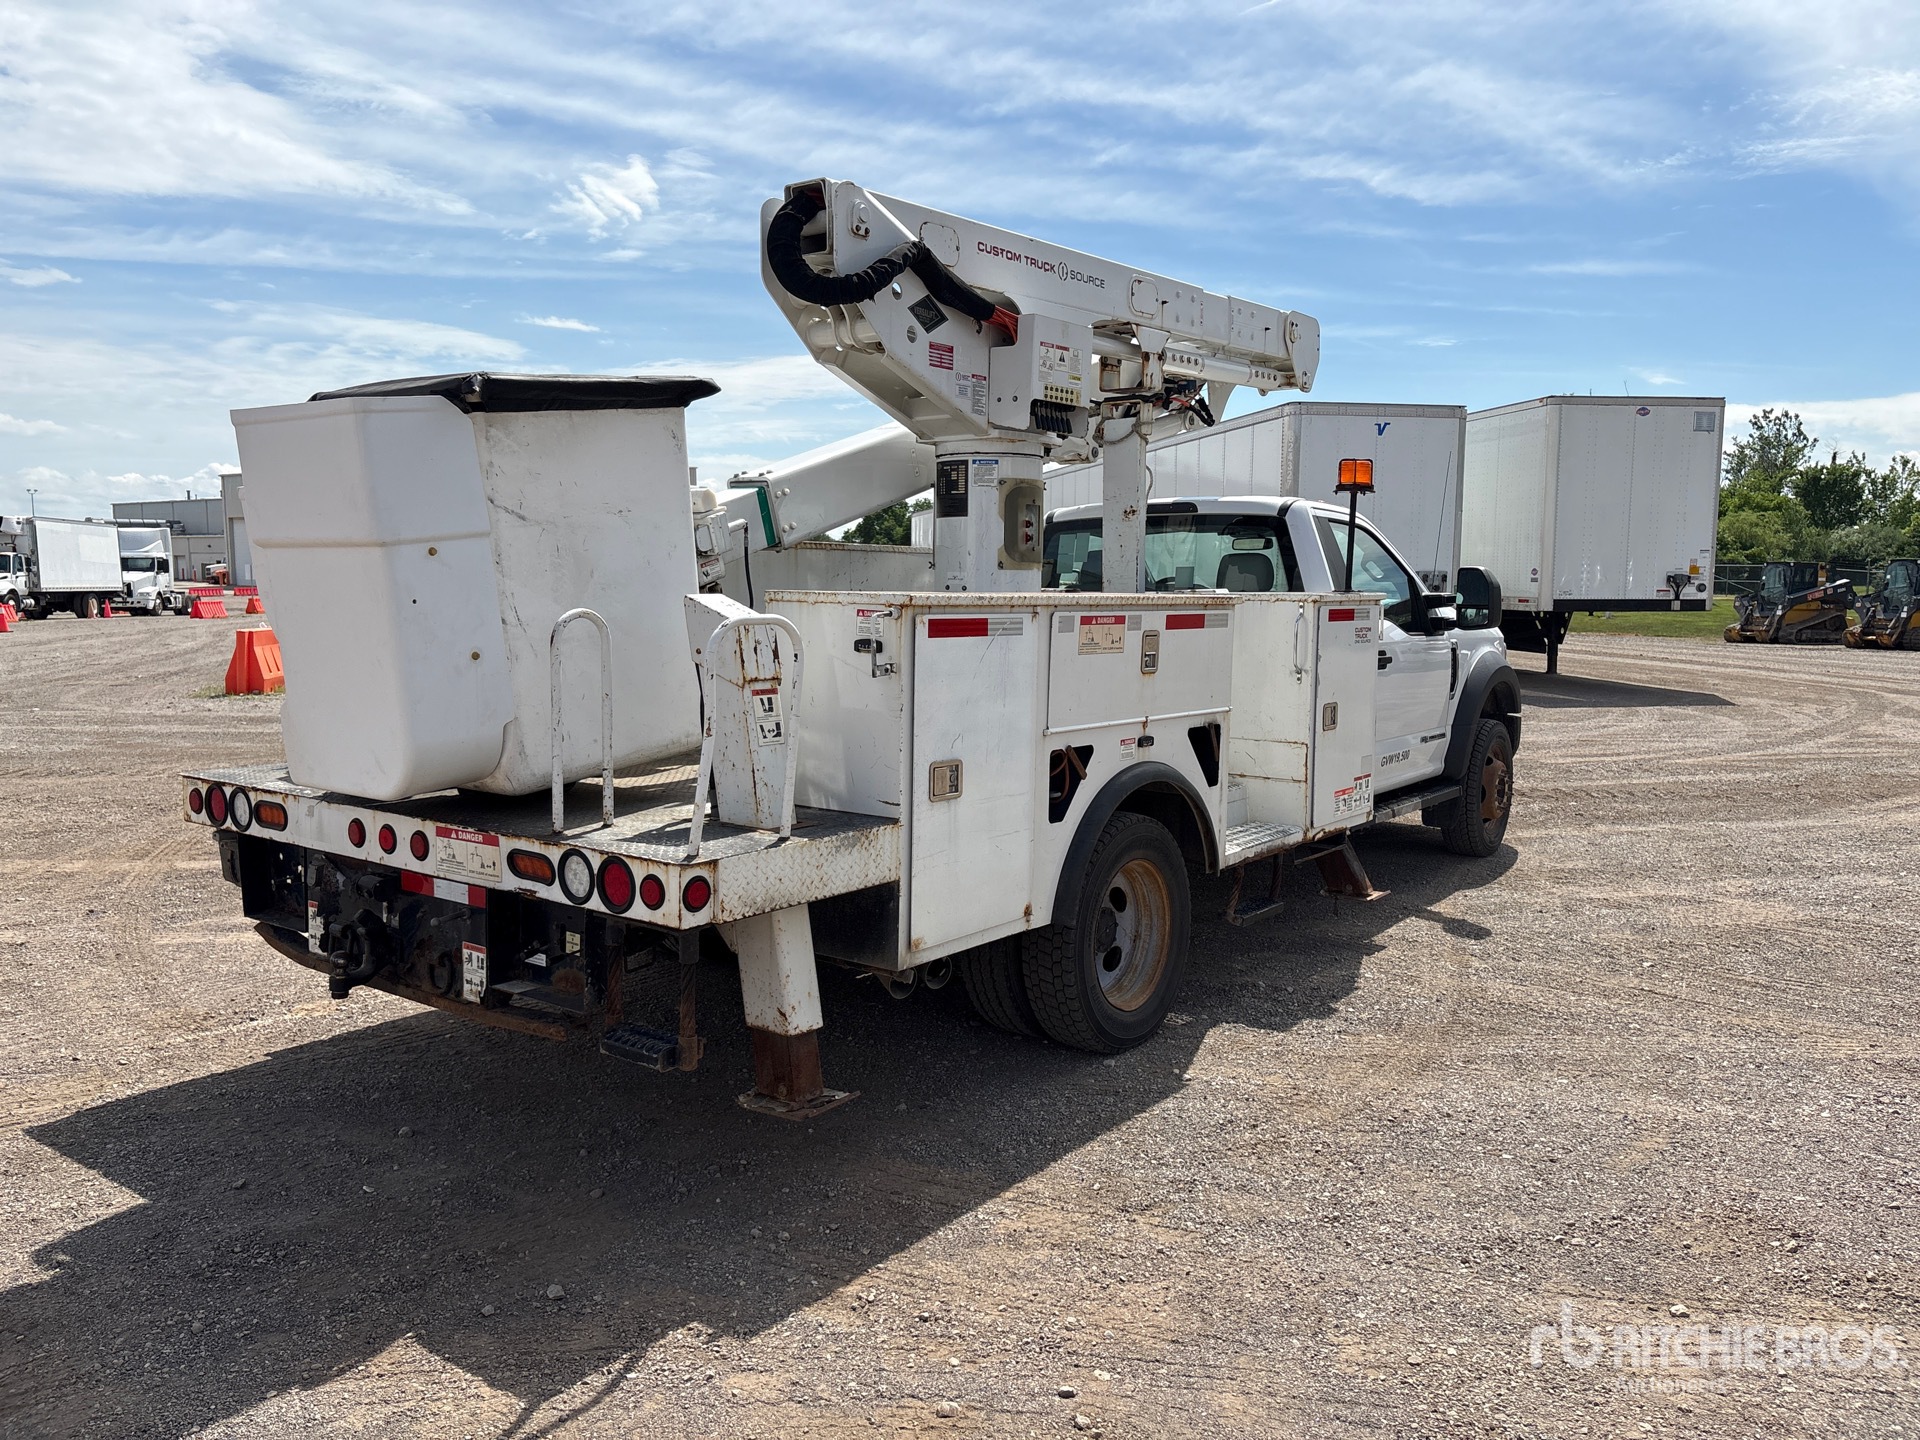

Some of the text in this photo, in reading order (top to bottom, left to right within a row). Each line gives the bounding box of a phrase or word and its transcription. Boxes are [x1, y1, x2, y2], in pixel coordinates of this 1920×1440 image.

[977, 241, 1022, 264] CUSTOM
[1023, 255, 1057, 275] TRUCK
[1069, 269, 1106, 289] SOURCE
[1097, 616, 1116, 624] DANGER
[458, 831, 483, 842] DANGER
